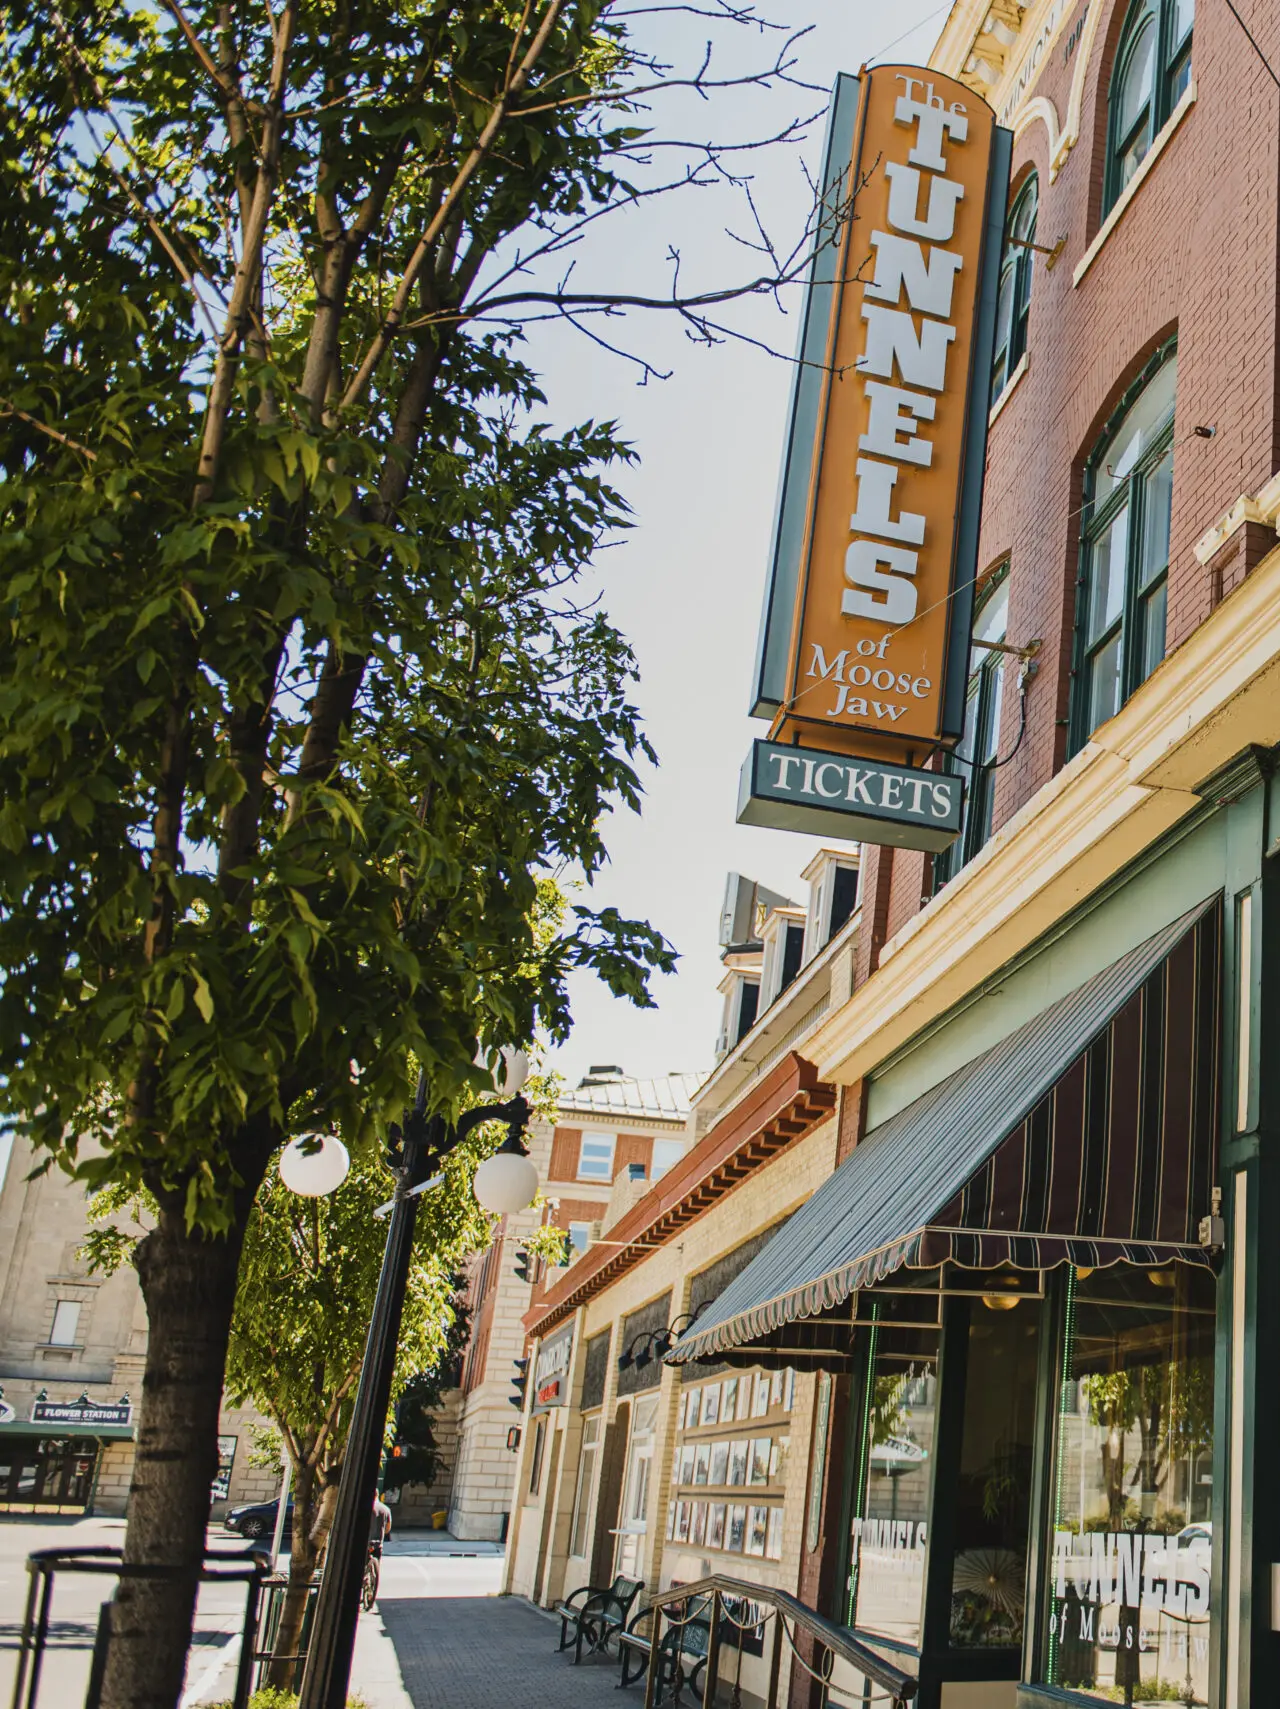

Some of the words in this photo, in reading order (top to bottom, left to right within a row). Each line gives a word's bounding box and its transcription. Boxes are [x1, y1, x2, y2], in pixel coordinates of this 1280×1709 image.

[895, 74, 967, 116] The
[841, 96, 969, 626] TUNNELS
[857, 632, 893, 660] of
[806, 643, 932, 699] Moose
[826, 684, 908, 722] Jaw
[769, 752, 952, 818] TICKETS
[44, 1407, 82, 1418] FLOWER
[82, 1409, 119, 1419] STATION
[1053, 1531, 1212, 1618] TUNNELS
[1049, 1603, 1068, 1645] of
[1079, 1605, 1147, 1652] Moose
